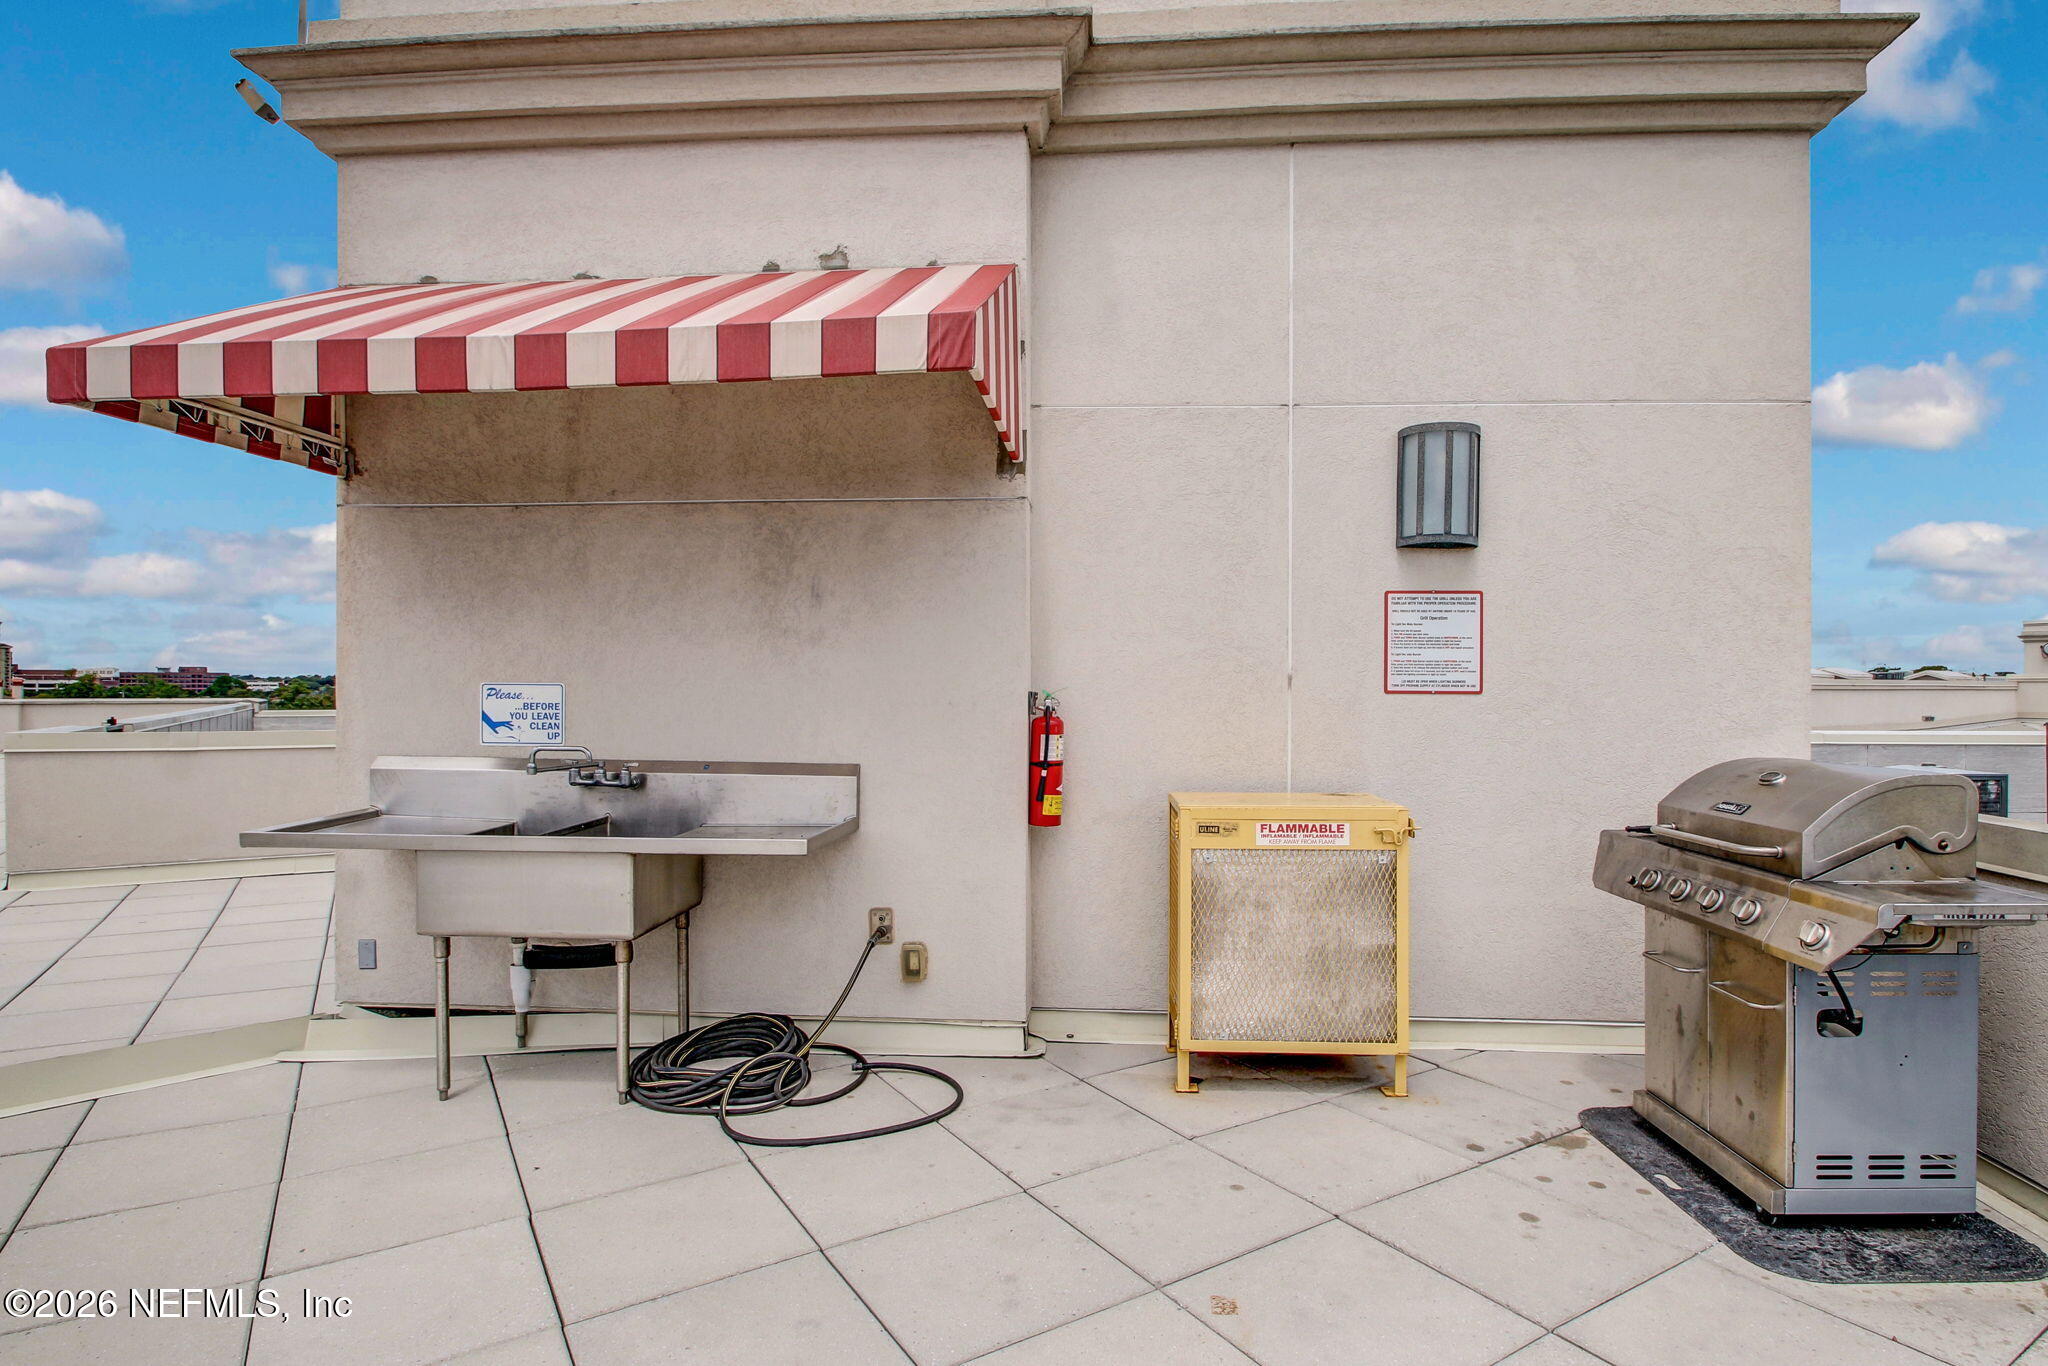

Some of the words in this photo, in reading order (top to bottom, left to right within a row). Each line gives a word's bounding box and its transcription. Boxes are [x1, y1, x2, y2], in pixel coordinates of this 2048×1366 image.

[510, 712, 528, 720] YOU
[532, 712, 560, 720] LEAVE
[530, 722, 560, 730] CLEAN
[548, 732, 560, 740] UP
[1260, 824, 1345, 833] FLAMMABLE
